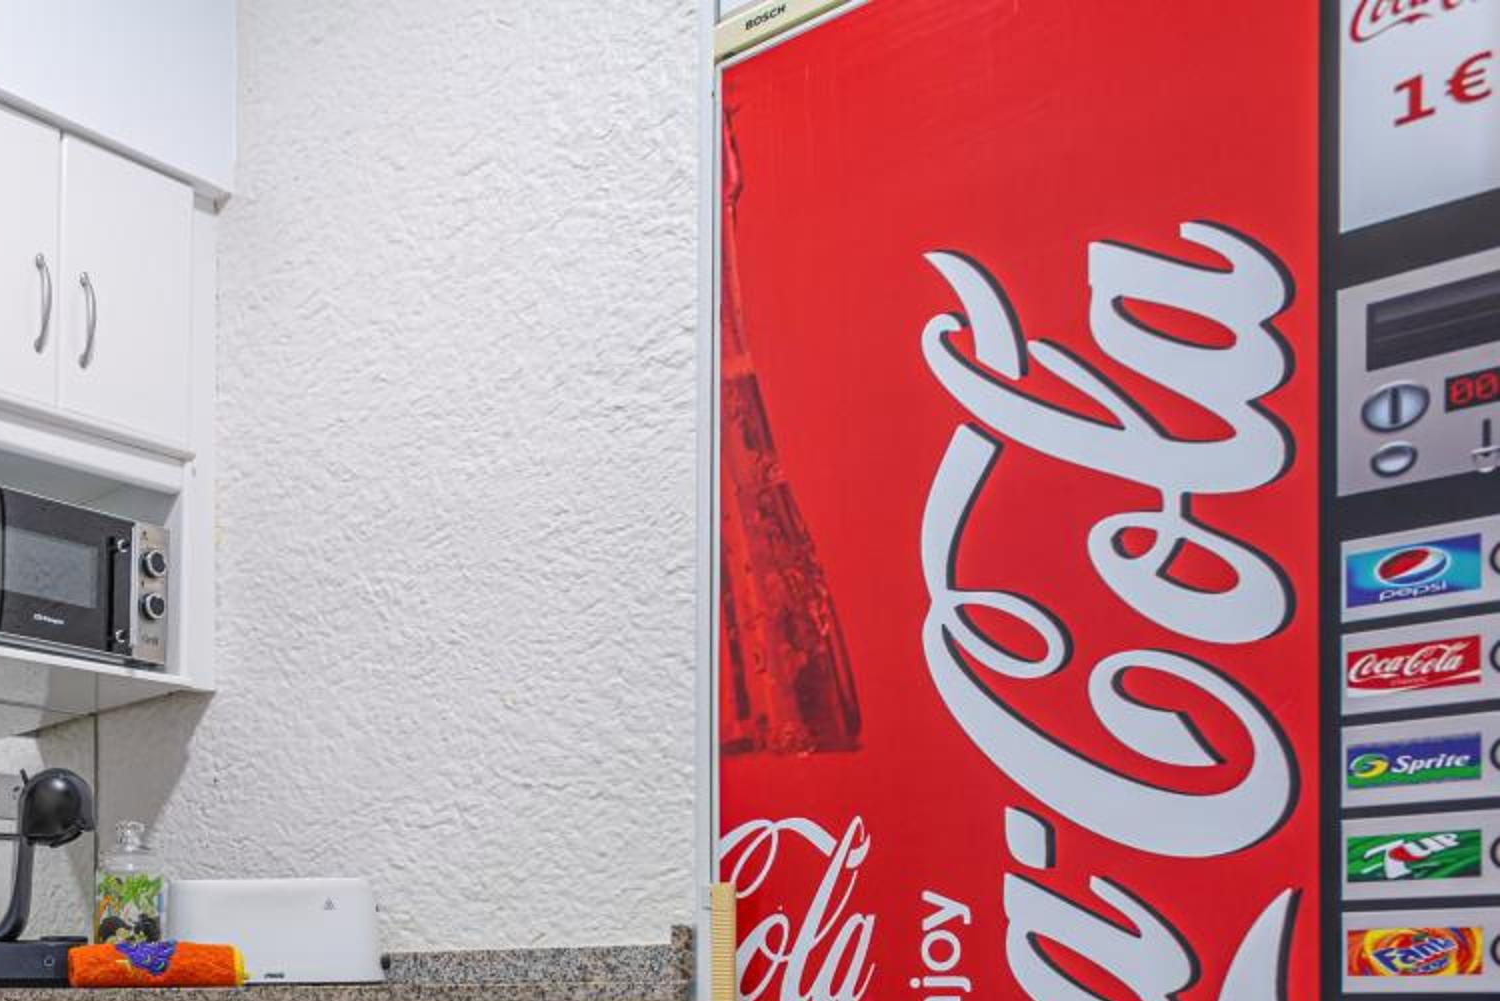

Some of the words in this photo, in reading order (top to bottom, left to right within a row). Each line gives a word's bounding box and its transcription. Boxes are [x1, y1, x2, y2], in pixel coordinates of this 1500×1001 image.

[745, 3, 787, 30] BOSCH
[1394, 73, 1436, 127] 1
[1445, 50, 1493, 104] €
[1379, 580, 1448, 602] pepsi
[1390, 752, 1471, 775] Sprite
